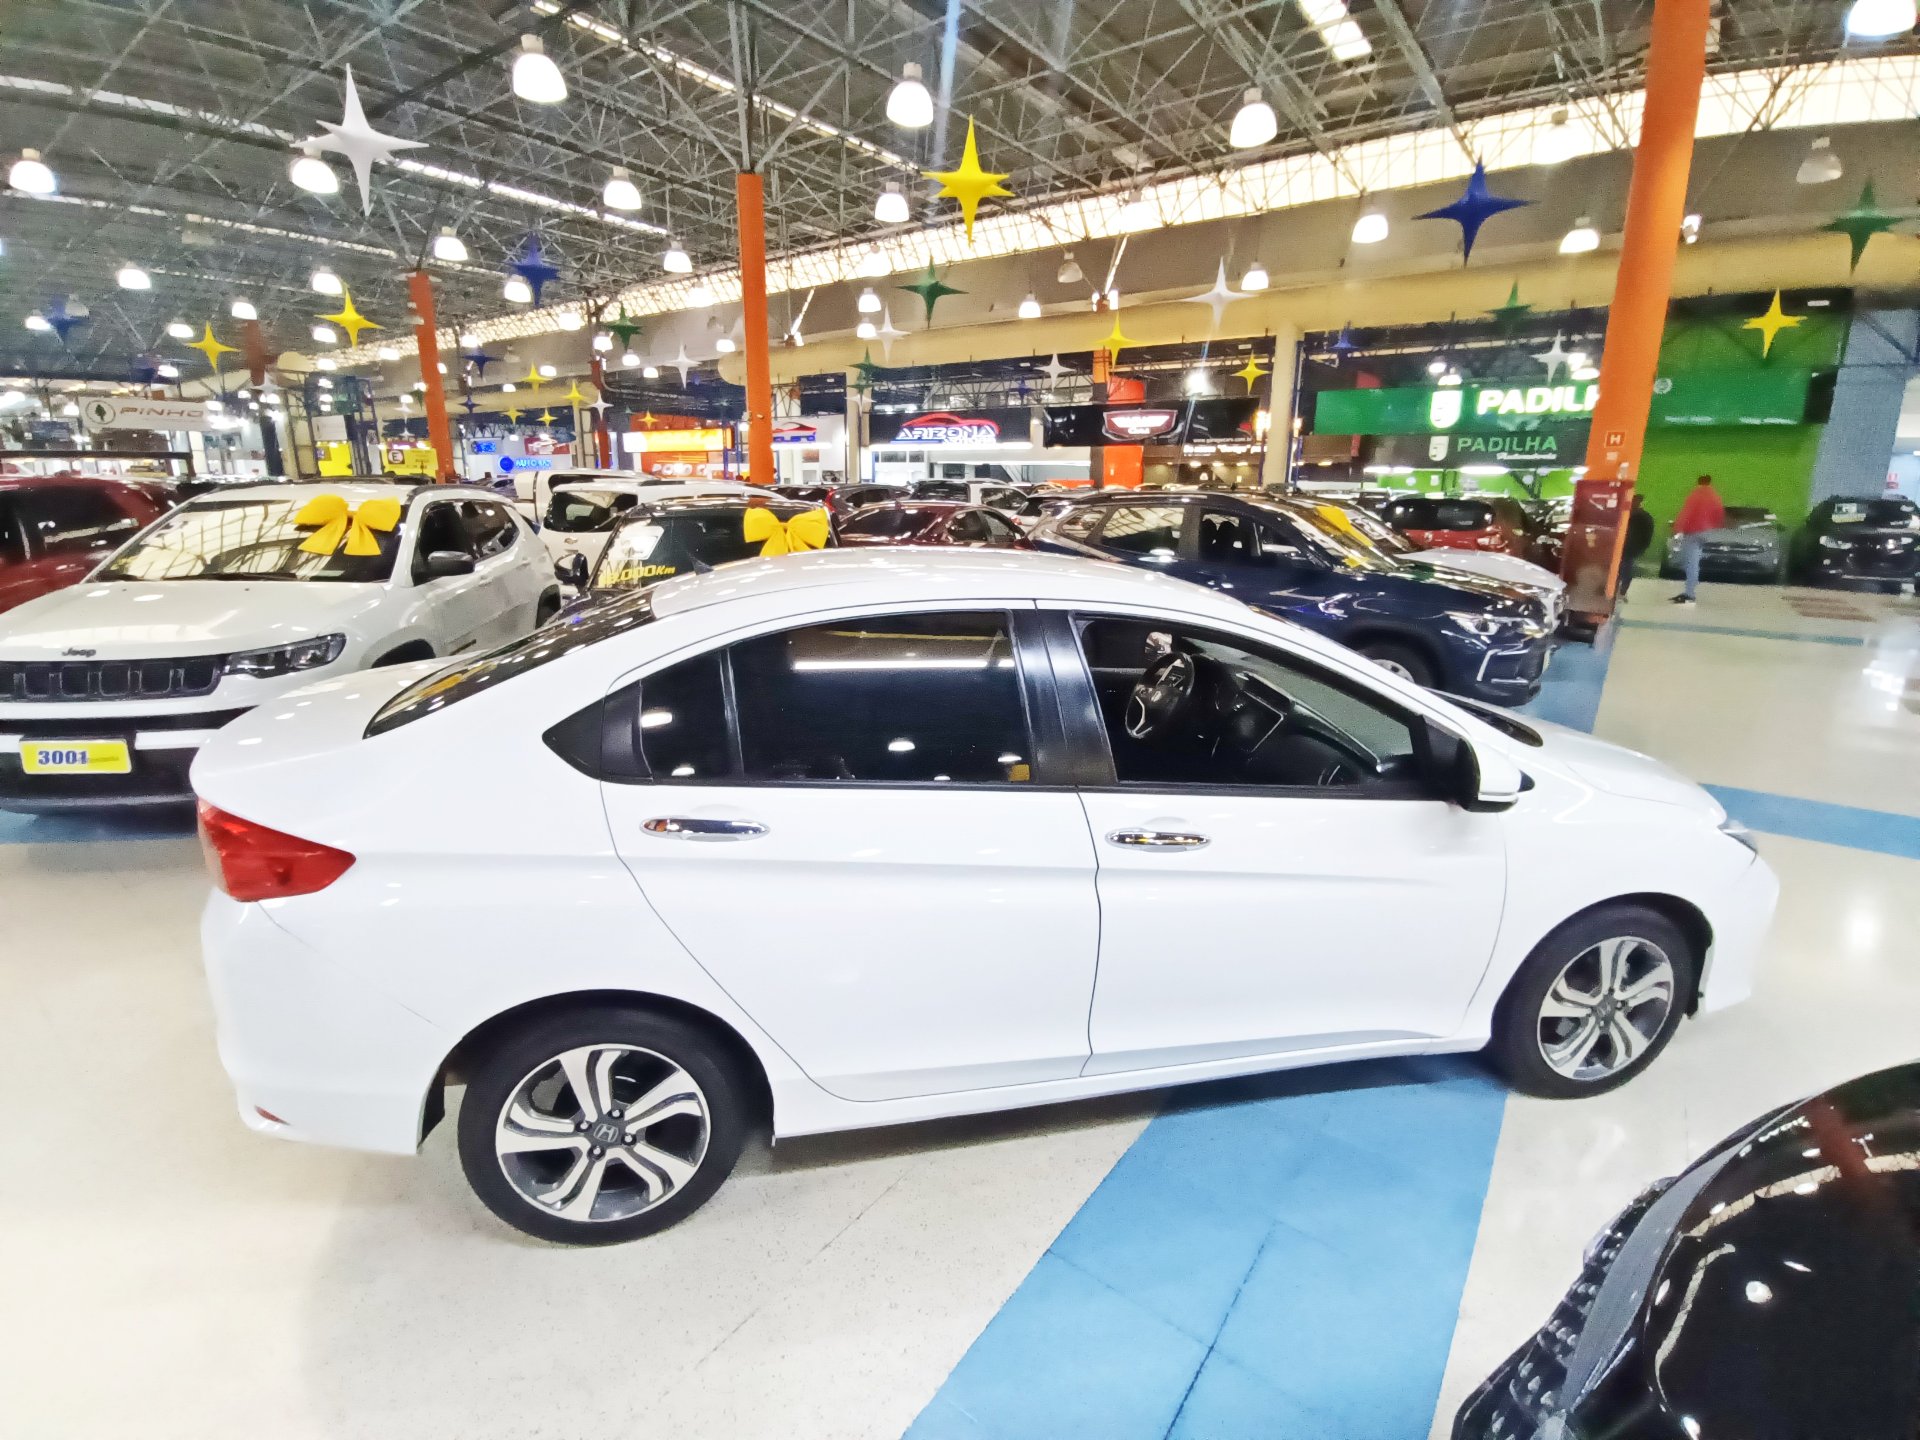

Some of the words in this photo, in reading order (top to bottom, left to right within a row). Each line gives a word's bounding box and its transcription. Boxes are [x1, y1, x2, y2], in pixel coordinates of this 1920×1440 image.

[896, 425, 997, 440] ARIZONA
[1457, 436, 1558, 452] PADILHA
[62, 648, 96, 658] Jeep
[38, 750, 88, 765] 3001
